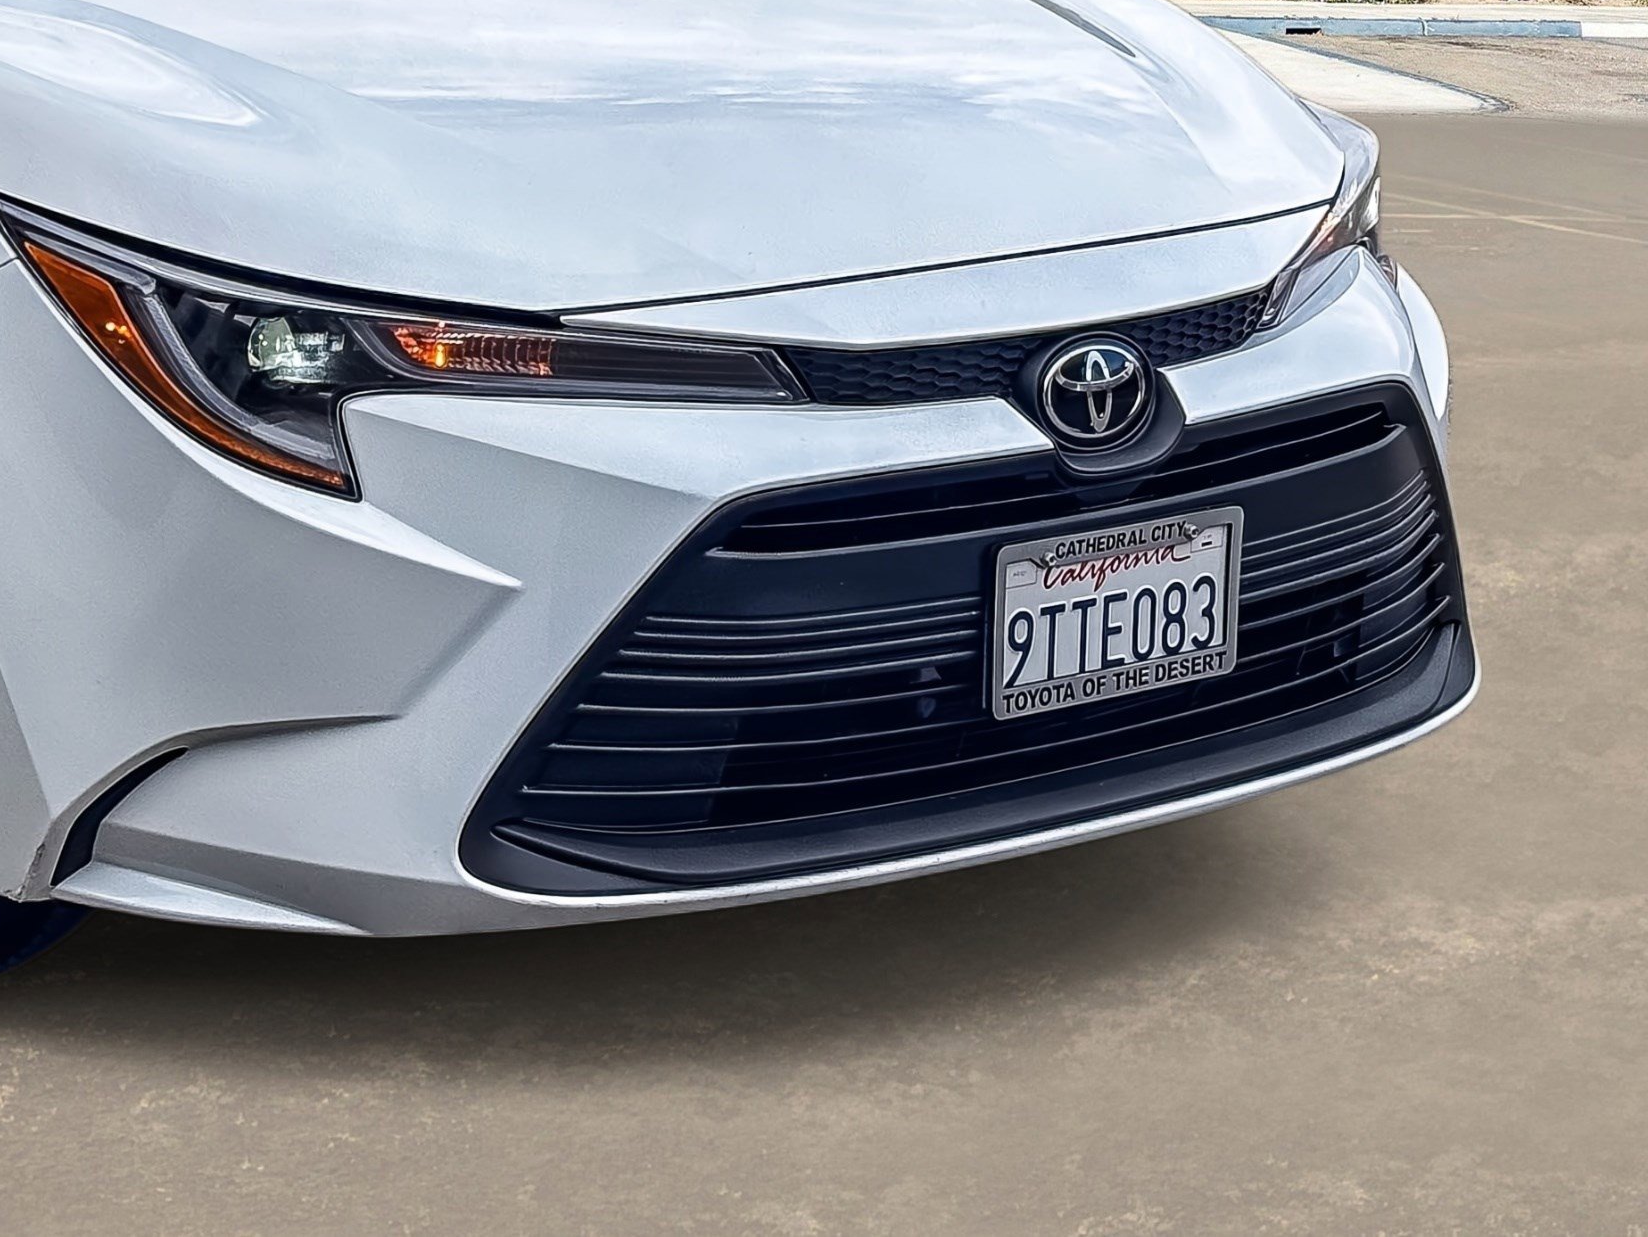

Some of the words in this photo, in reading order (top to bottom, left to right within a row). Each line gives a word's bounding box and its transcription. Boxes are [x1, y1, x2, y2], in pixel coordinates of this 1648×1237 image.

[1055, 528, 1147, 560] CATHEDRAL
[1151, 520, 1188, 549] CITY
[1042, 544, 1191, 592] California
[1003, 575, 1217, 689] 9TTE083
[1003, 680, 1077, 713] TOYOTA
[1082, 675, 1107, 697] OF
[1112, 665, 1150, 690] THE
[1154, 650, 1228, 682] DESERT
